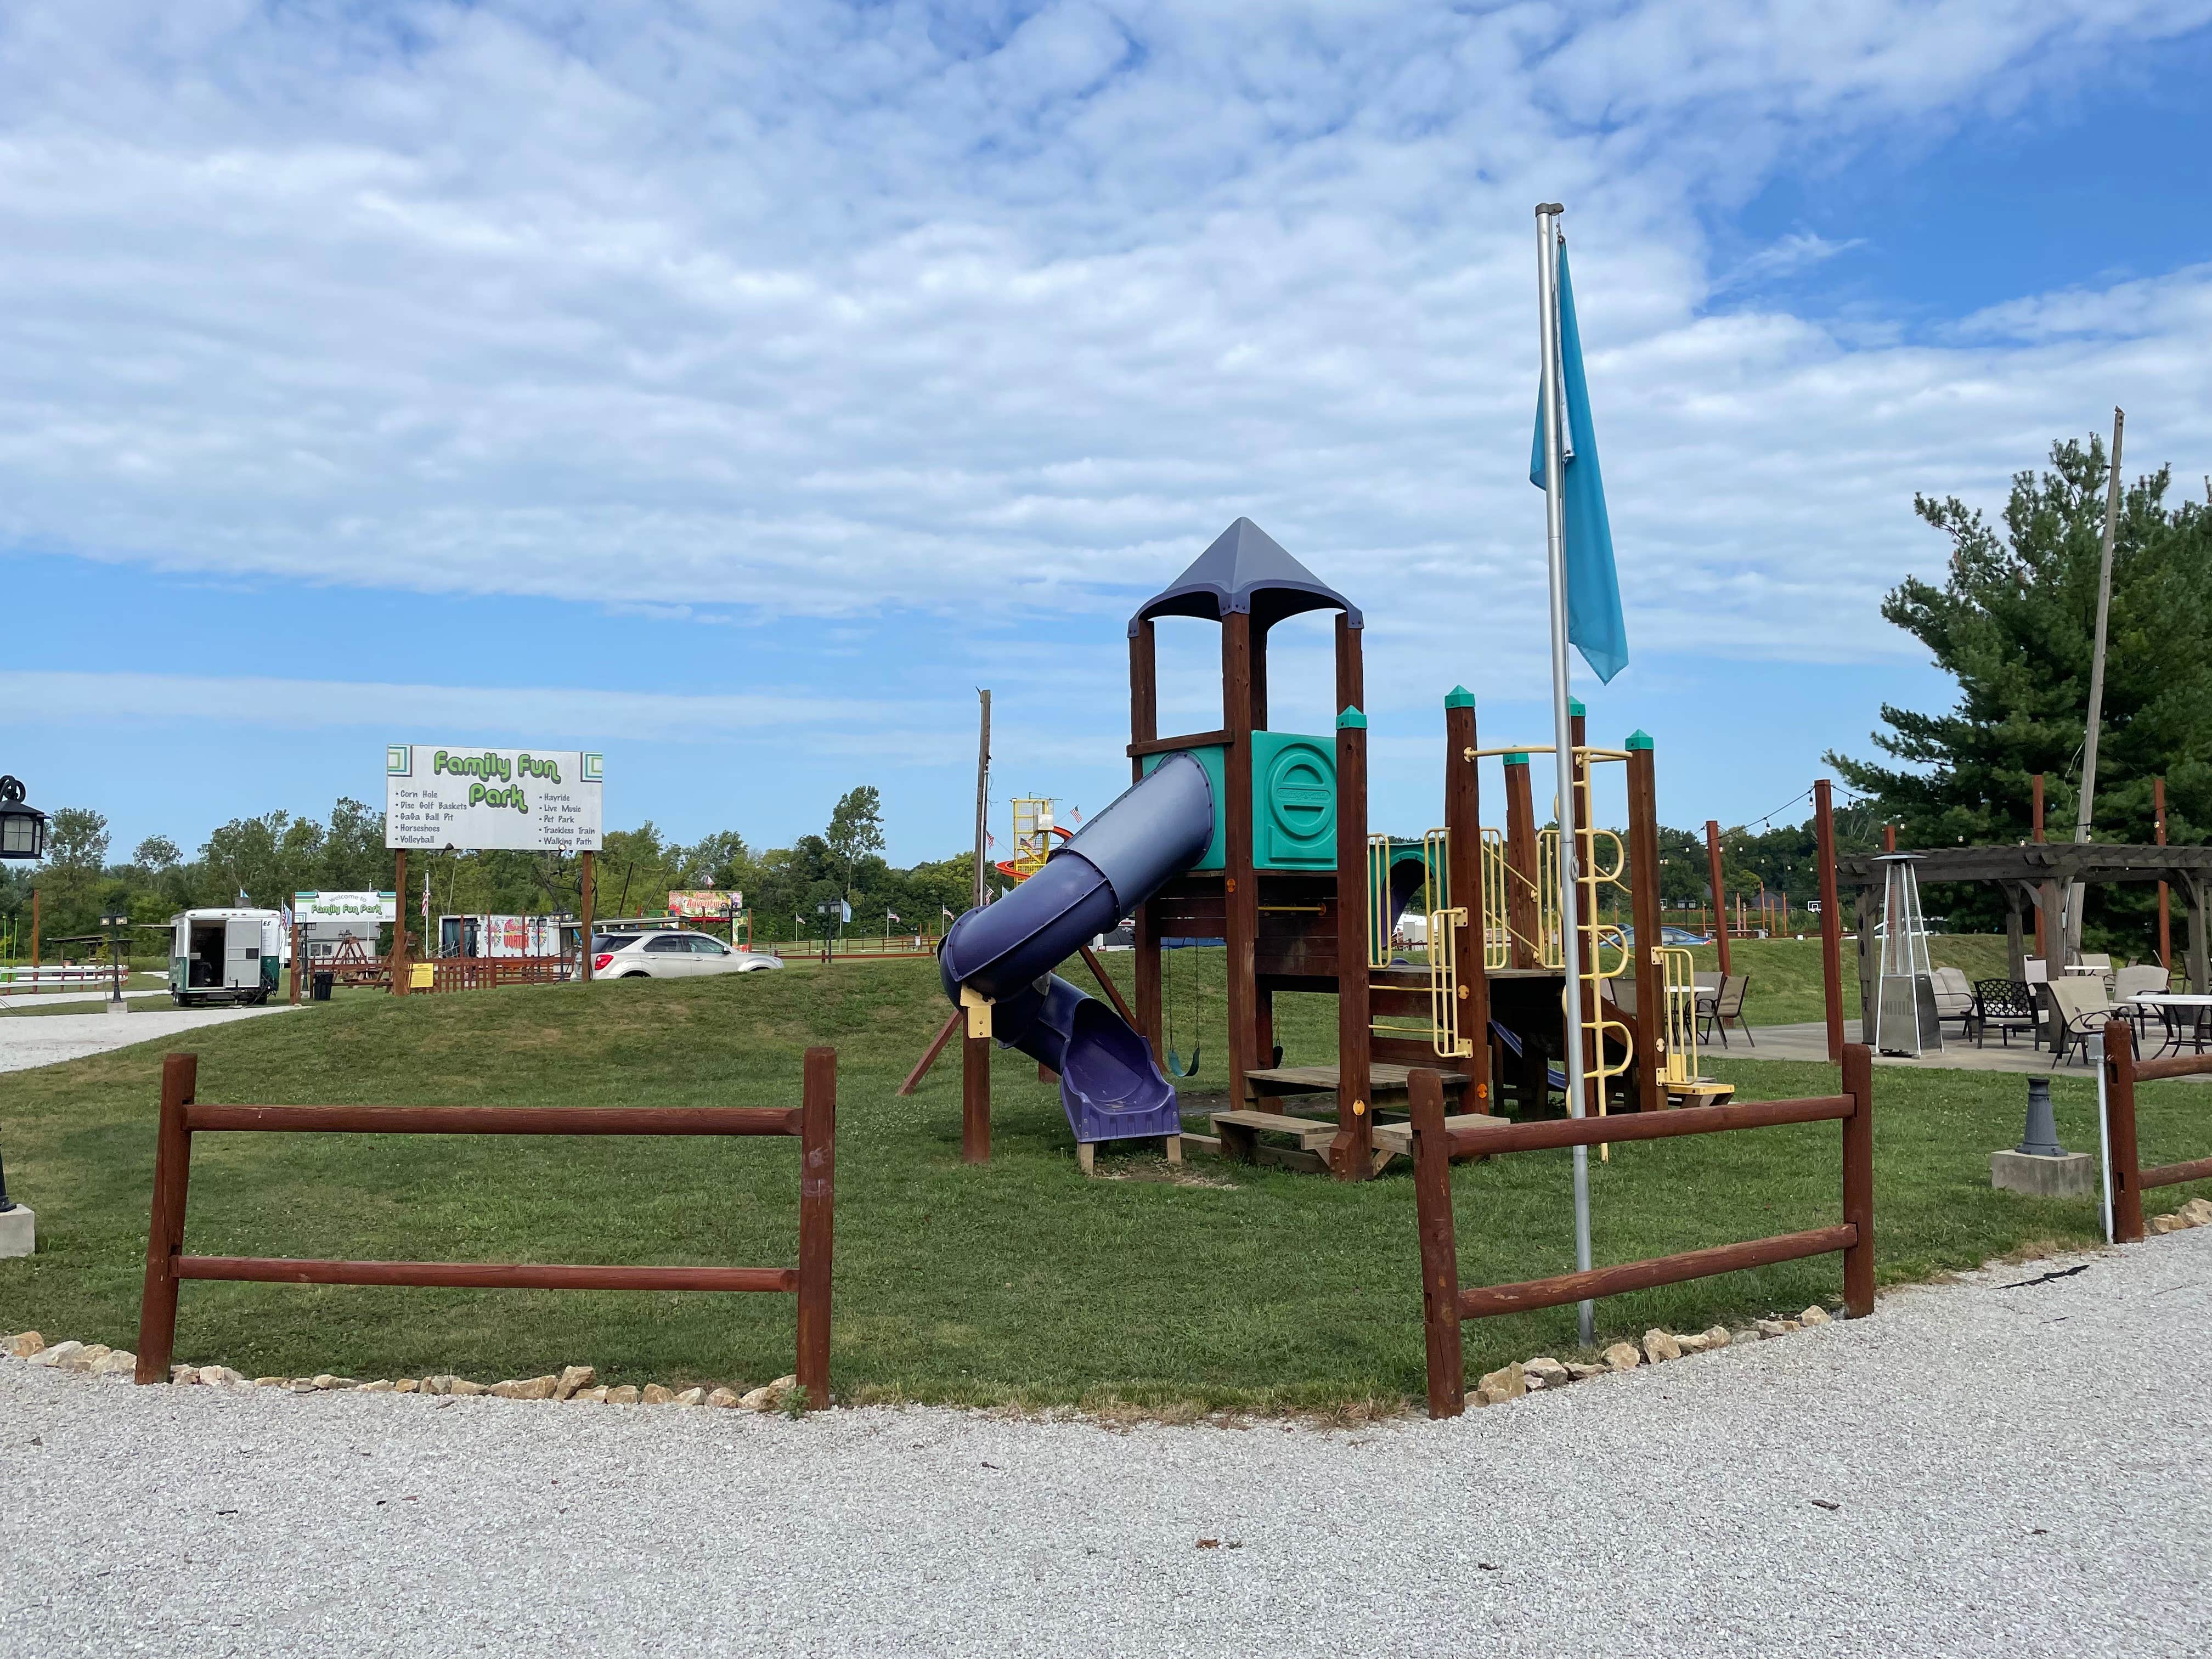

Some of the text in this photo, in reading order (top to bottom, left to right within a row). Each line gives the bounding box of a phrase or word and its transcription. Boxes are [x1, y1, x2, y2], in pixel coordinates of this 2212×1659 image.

[434, 751, 561, 784] Family Fun
[422, 790, 437, 798] Hole
[469, 783, 528, 814] Park
[544, 793, 570, 802] Hayride
[400, 823, 440, 832] Horseshoes
[400, 836, 435, 844] Volleyball
[544, 837, 572, 845] Walking
[329, 894, 359, 902] welcome
[311, 904, 382, 916] Family Fun Park
